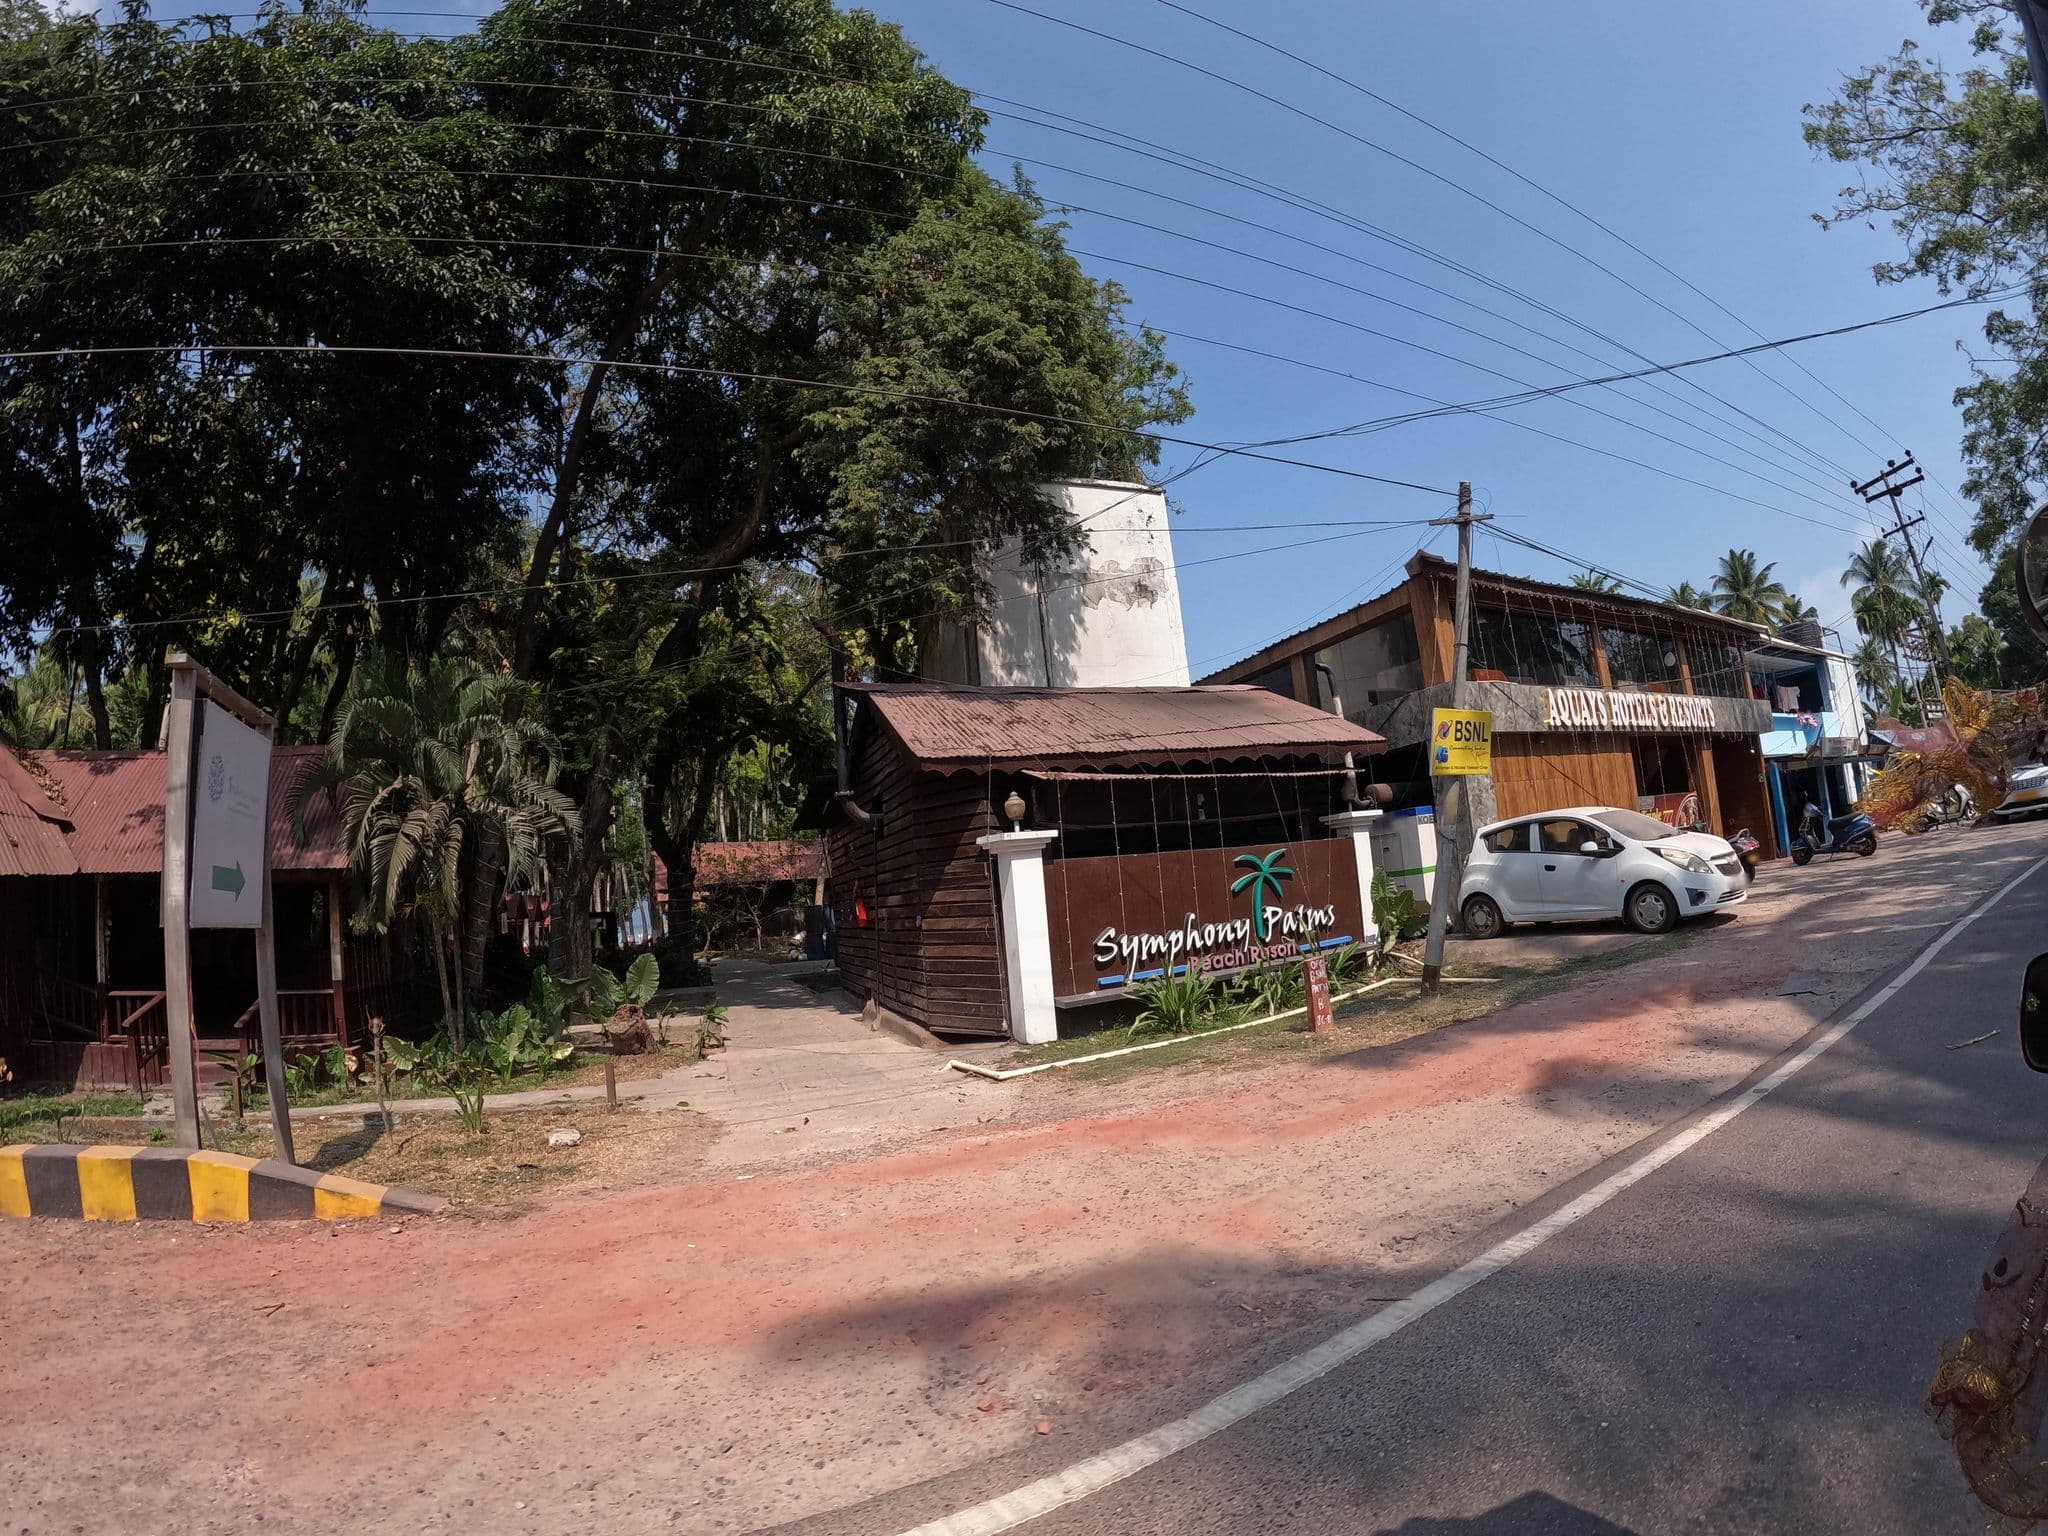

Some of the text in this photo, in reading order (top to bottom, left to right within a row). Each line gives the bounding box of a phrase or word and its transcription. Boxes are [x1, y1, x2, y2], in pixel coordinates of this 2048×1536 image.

[1546, 688, 1608, 726] AQUAYS
[1608, 691, 1659, 727] HOTELS
[1669, 697, 1716, 728] RESORTS
[1454, 720, 1489, 743] BSNL
[1096, 904, 1335, 985] Symphony Palms
[1189, 948, 1246, 973] Beach
